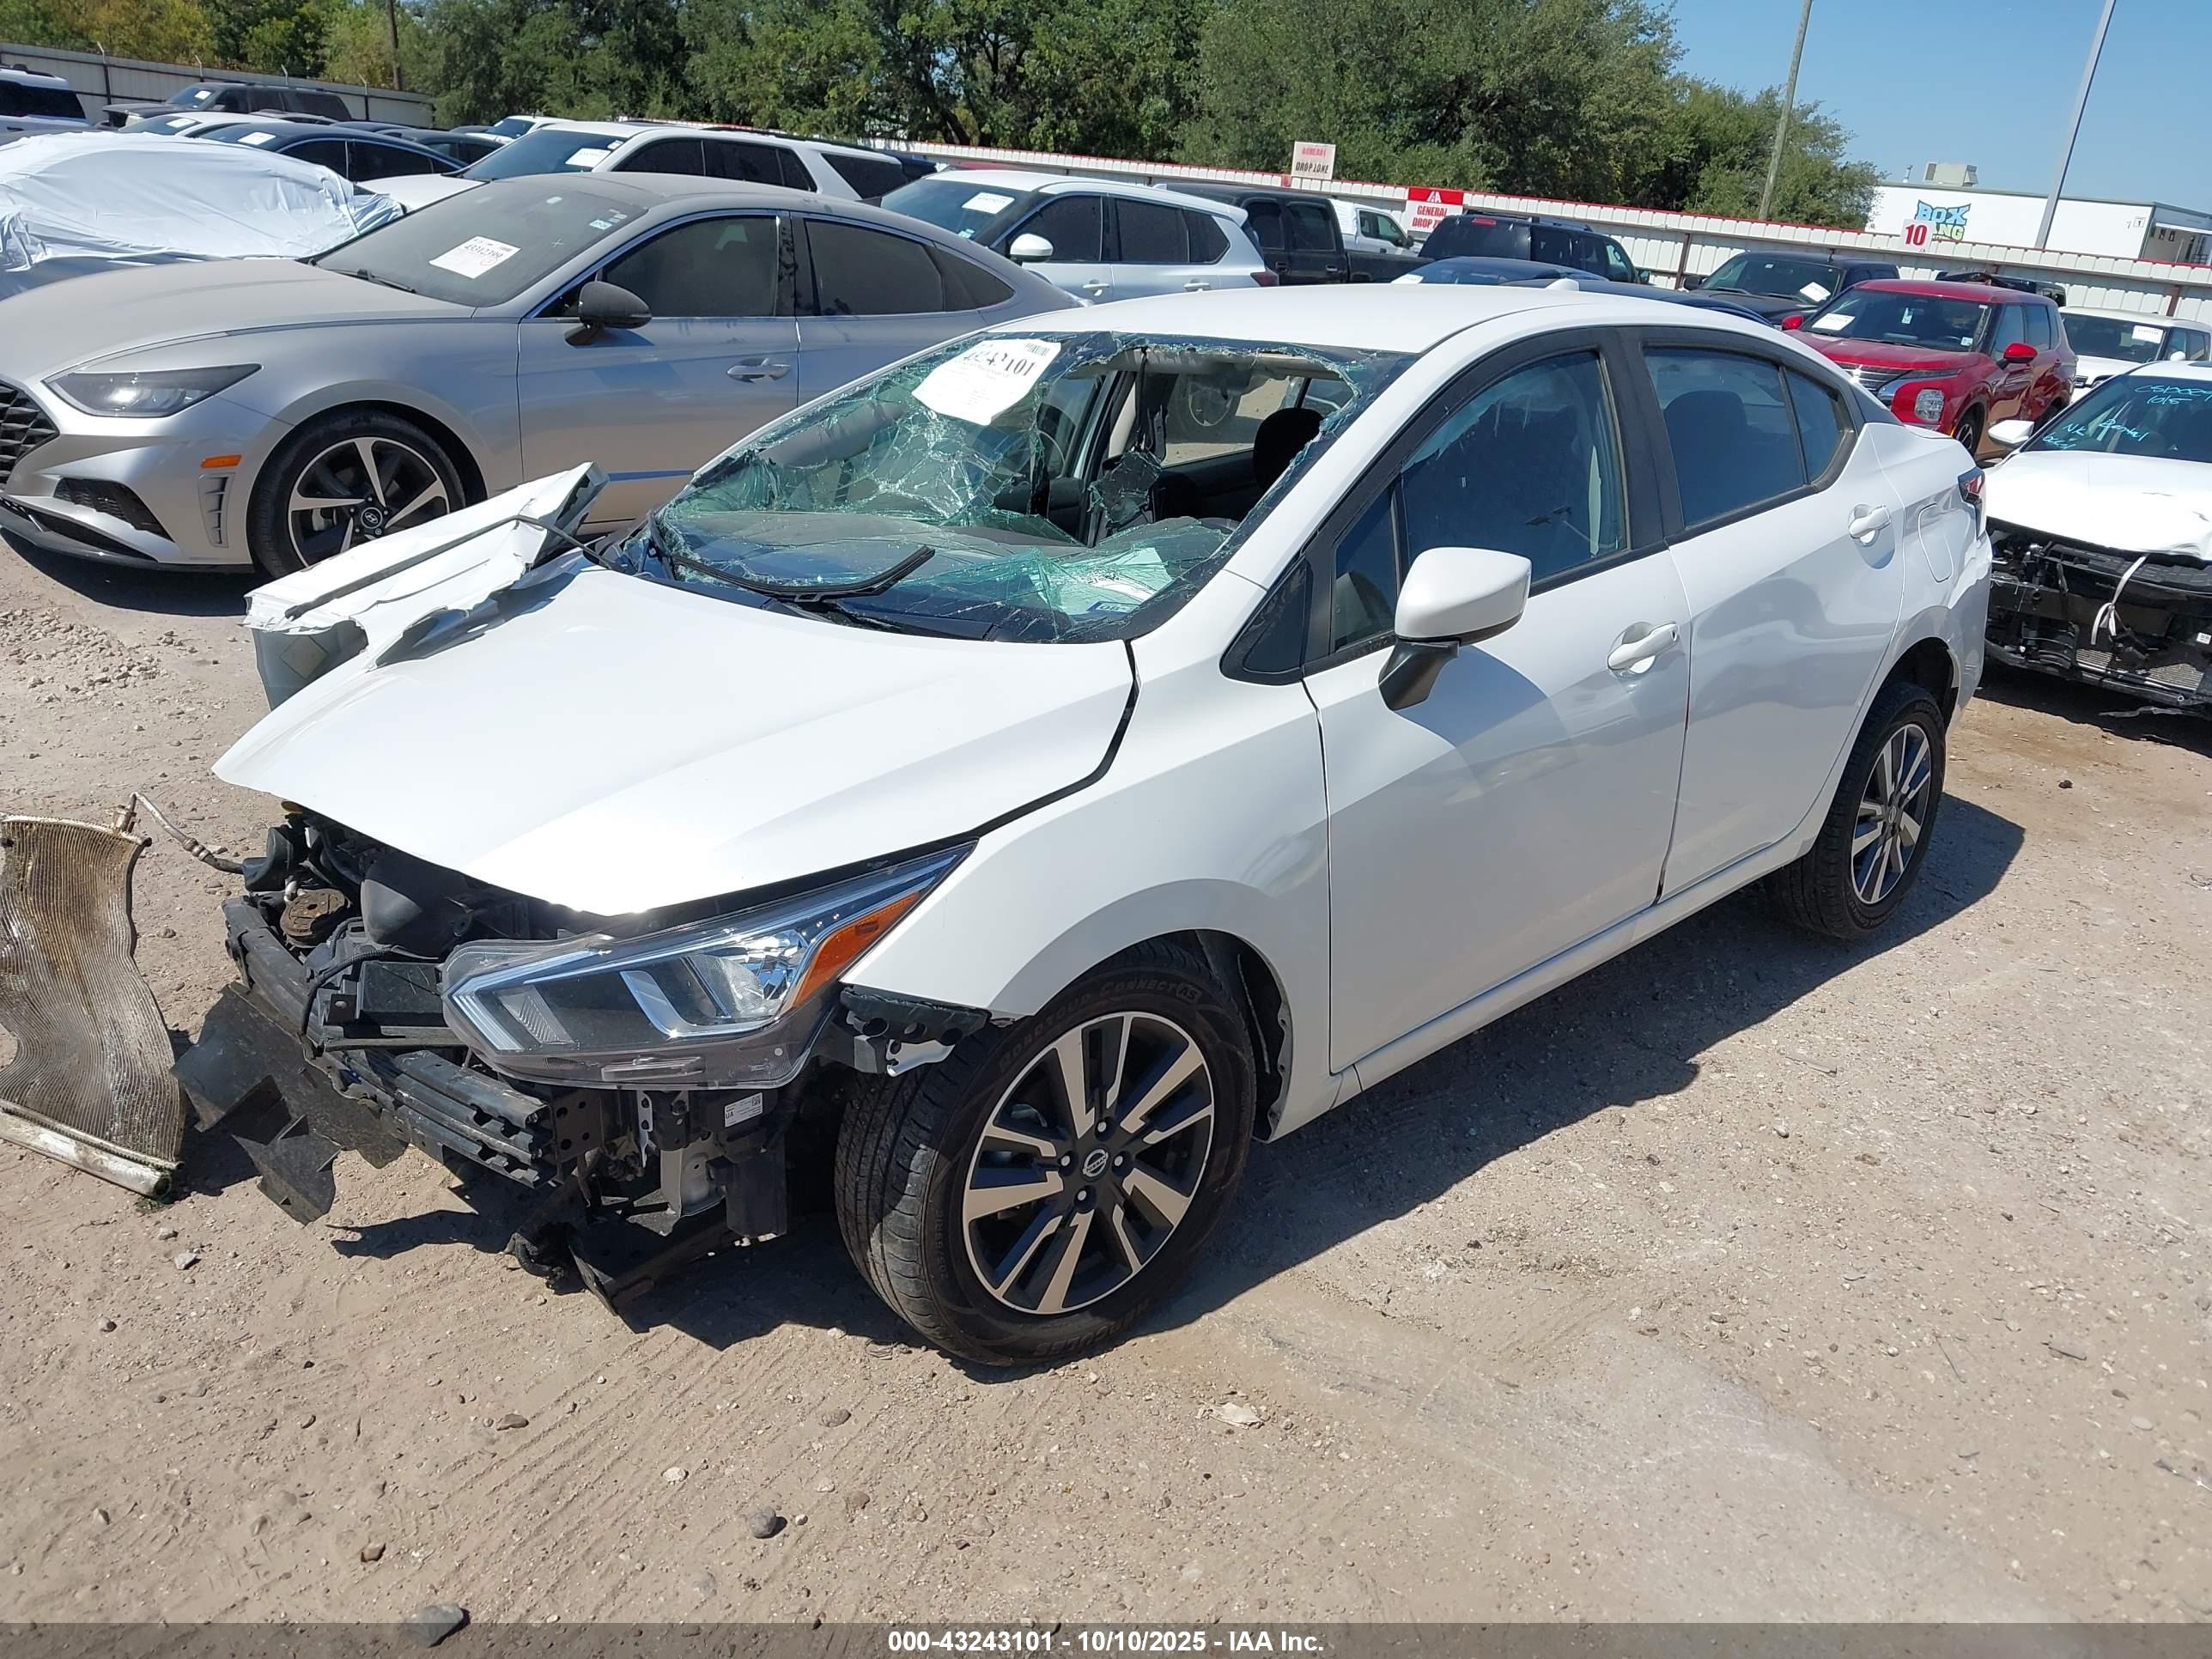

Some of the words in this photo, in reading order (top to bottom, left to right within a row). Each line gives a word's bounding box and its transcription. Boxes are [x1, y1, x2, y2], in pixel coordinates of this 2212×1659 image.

[1295, 161, 1313, 173] DROP
[1417, 204, 1448, 217] GENERAL
[1914, 199, 1972, 226] BOX
[1412, 217, 1431, 228] DROP
[1904, 224, 1928, 246] 10
